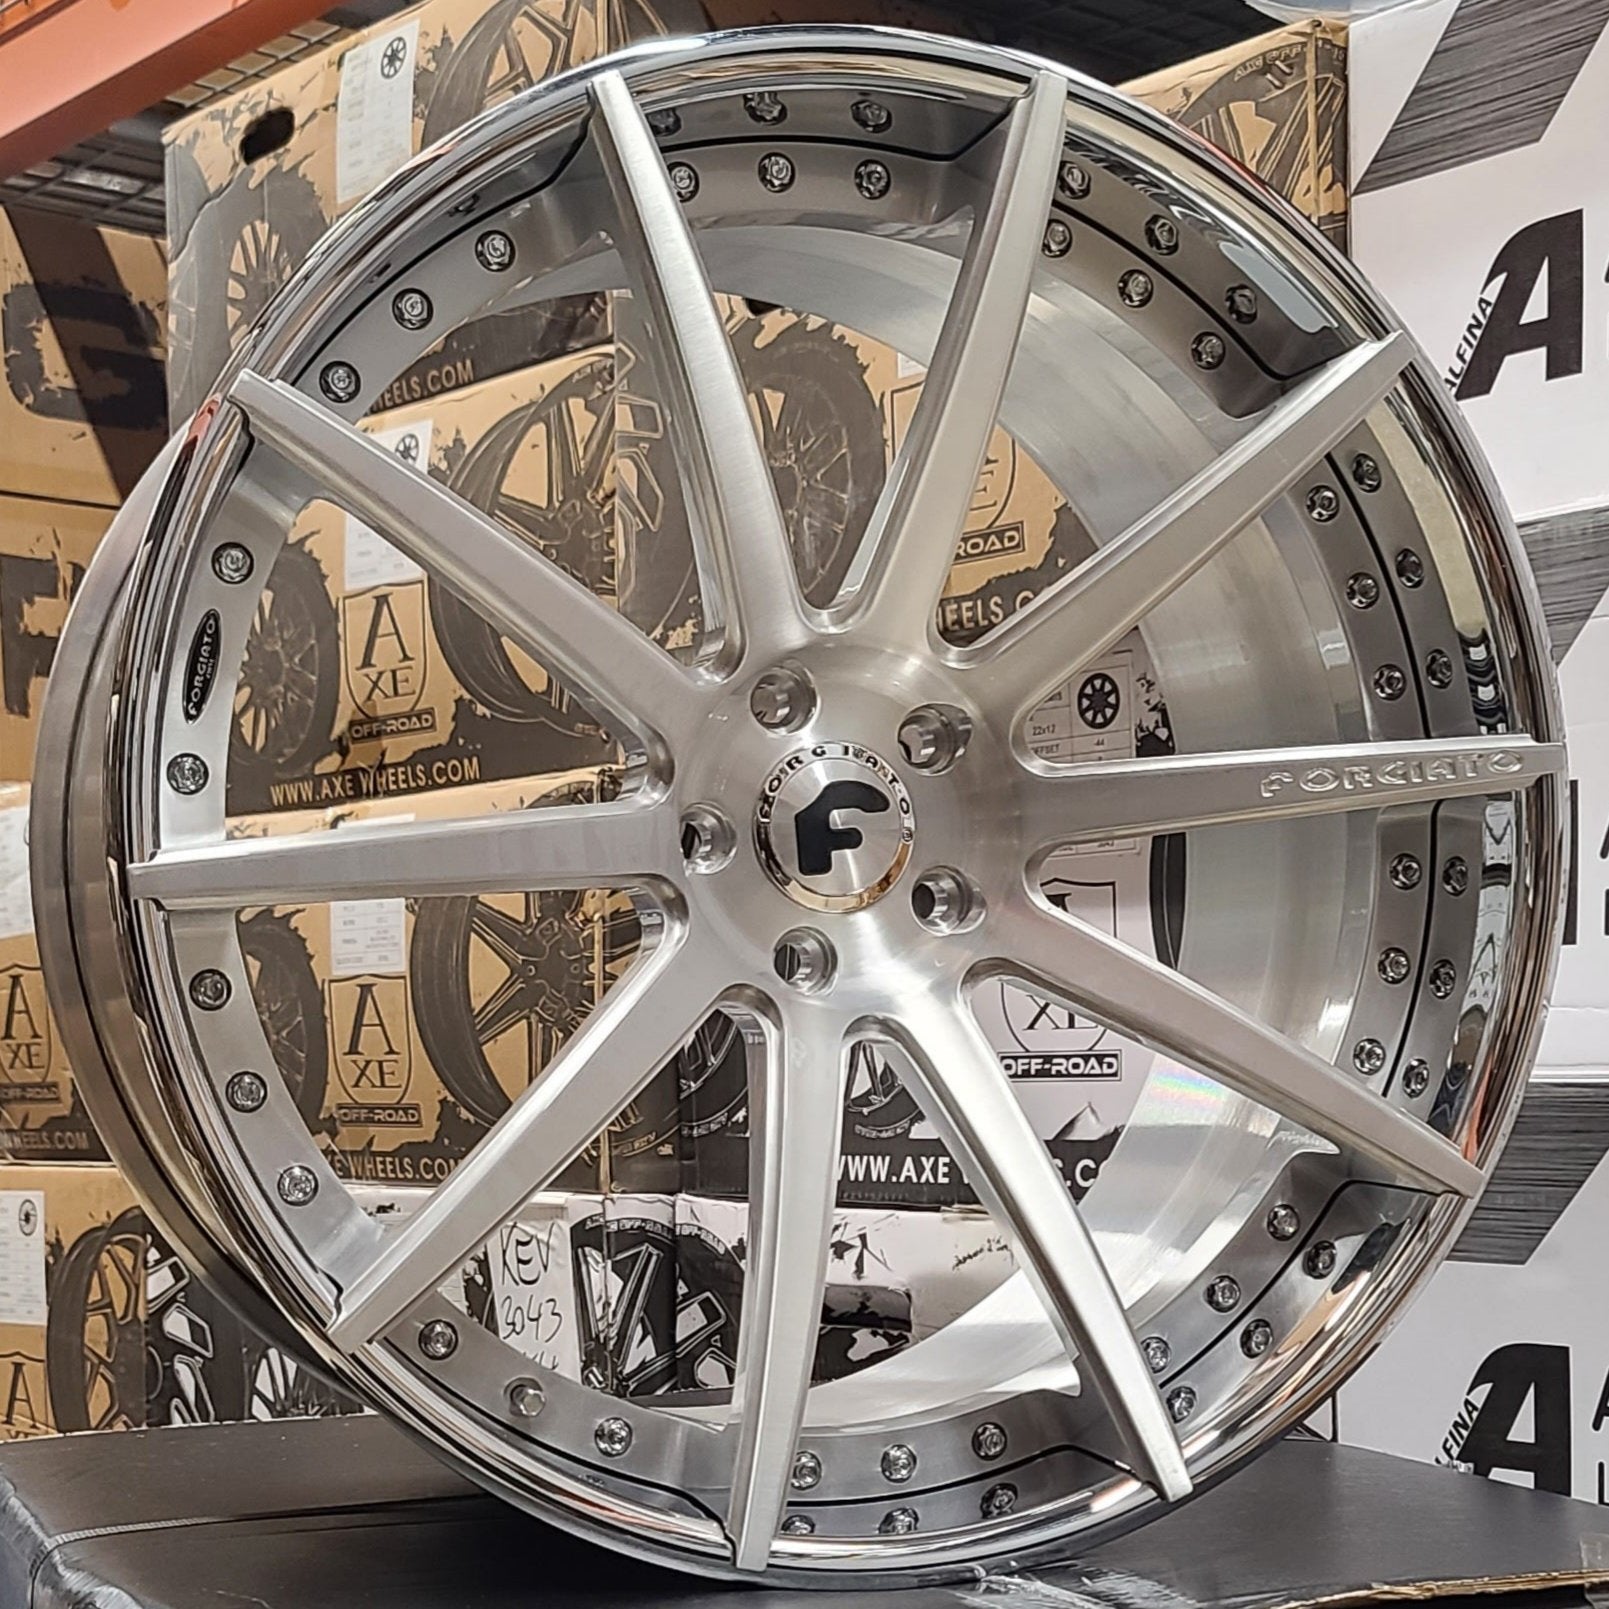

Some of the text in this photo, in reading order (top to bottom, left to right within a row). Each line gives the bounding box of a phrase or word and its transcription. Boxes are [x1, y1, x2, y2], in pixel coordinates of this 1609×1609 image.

[188, 619, 216, 716] FORGIATO
[352, 713, 433, 739] OFF-ROAD
[270, 756, 480, 806] WWW.AXE WHEELS.COM
[758, 744, 911, 824] FORGIATO
[1260, 749, 1524, 798] FORGIATO
[794, 779, 890, 877] F
[340, 1107, 419, 1123] OFF-ROAD
[501, 1221, 558, 1287] KEV
